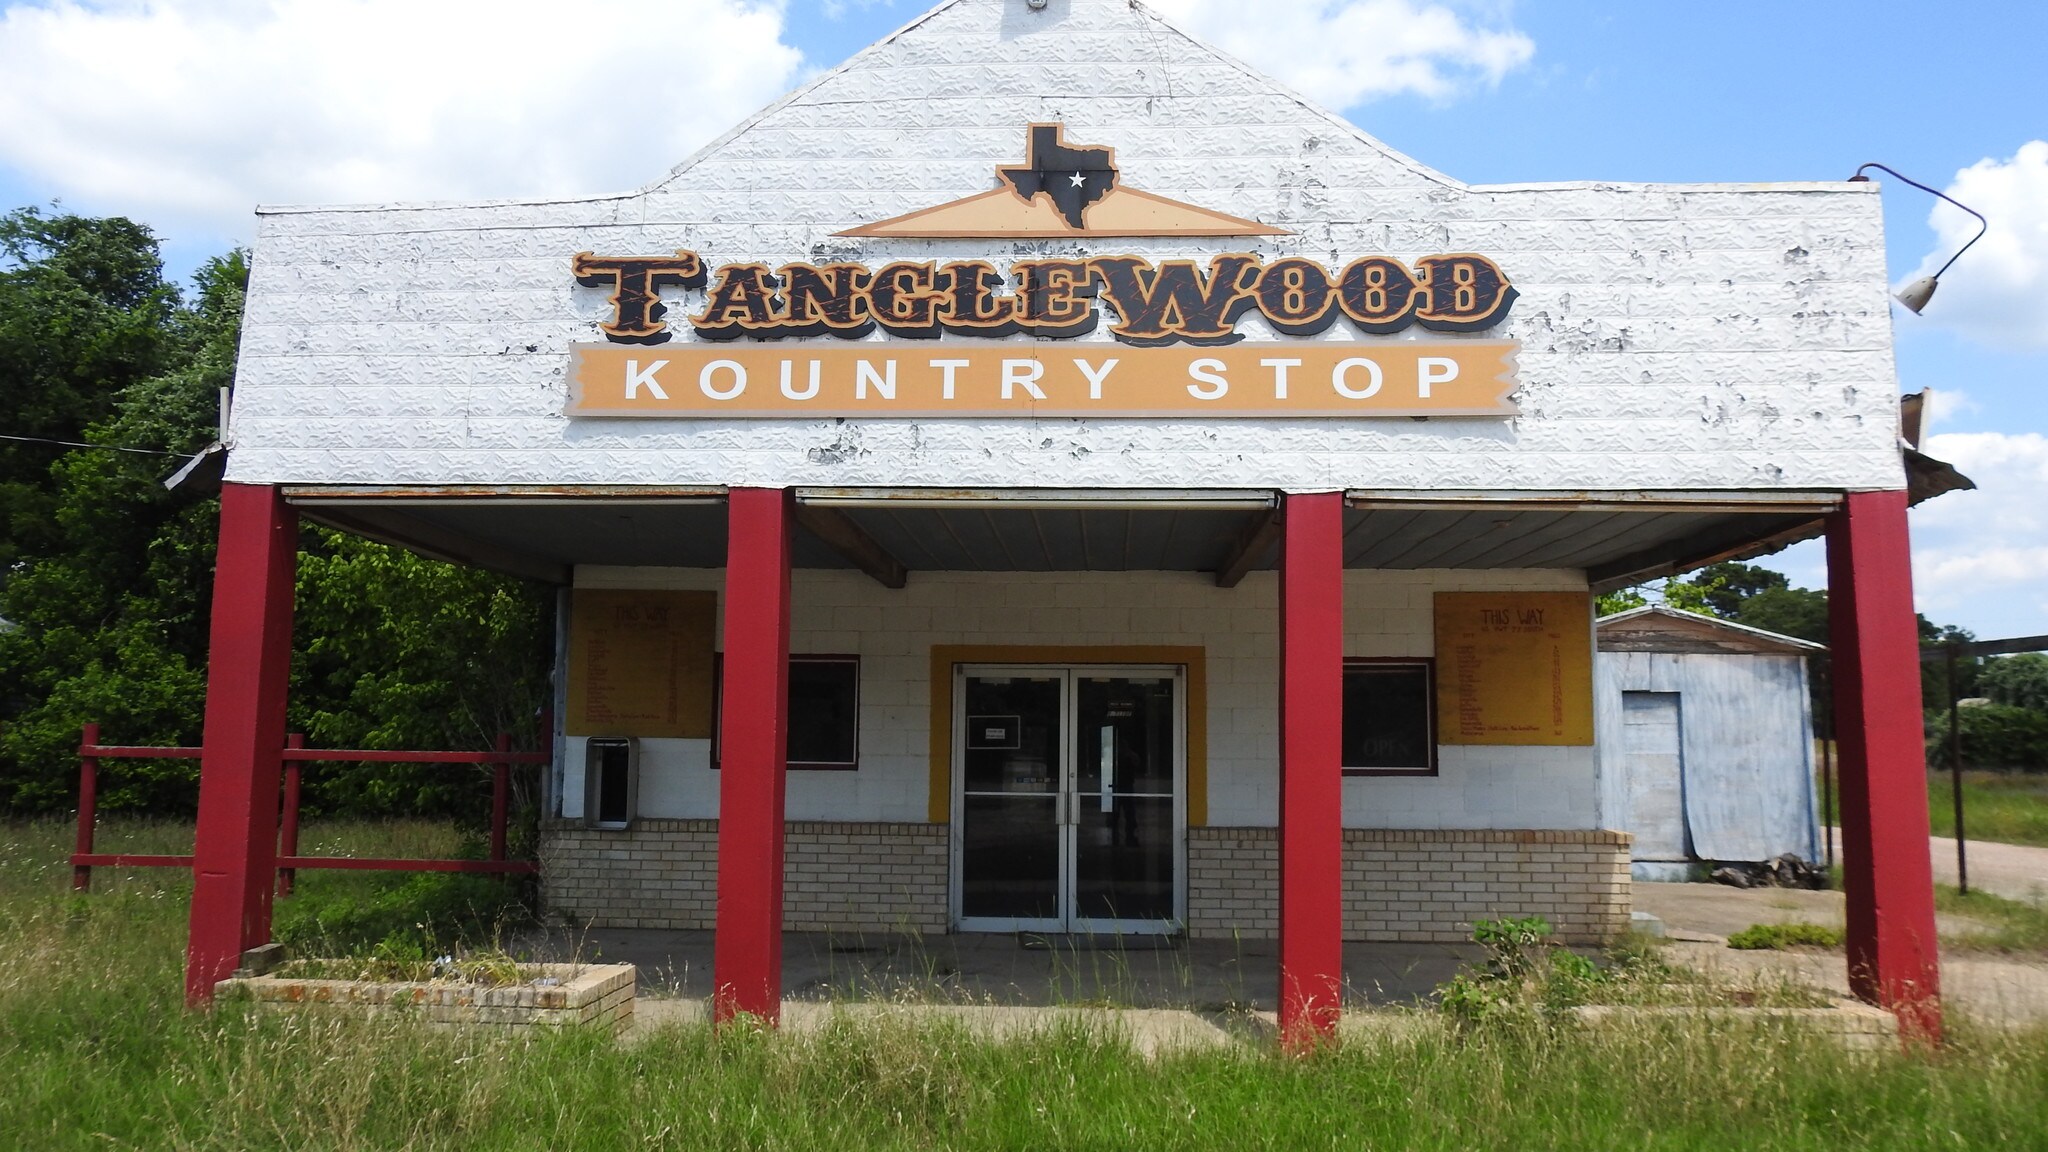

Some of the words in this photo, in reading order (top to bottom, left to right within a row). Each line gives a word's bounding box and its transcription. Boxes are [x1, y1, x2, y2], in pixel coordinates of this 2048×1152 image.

[573, 250, 1518, 346] TANGLEWOOD
[624, 358, 1120, 400] KOUNTRY
[1186, 357, 1460, 400] STOP
[1480, 608, 1510, 625] THIS
[1516, 608, 1545, 625] WAY
